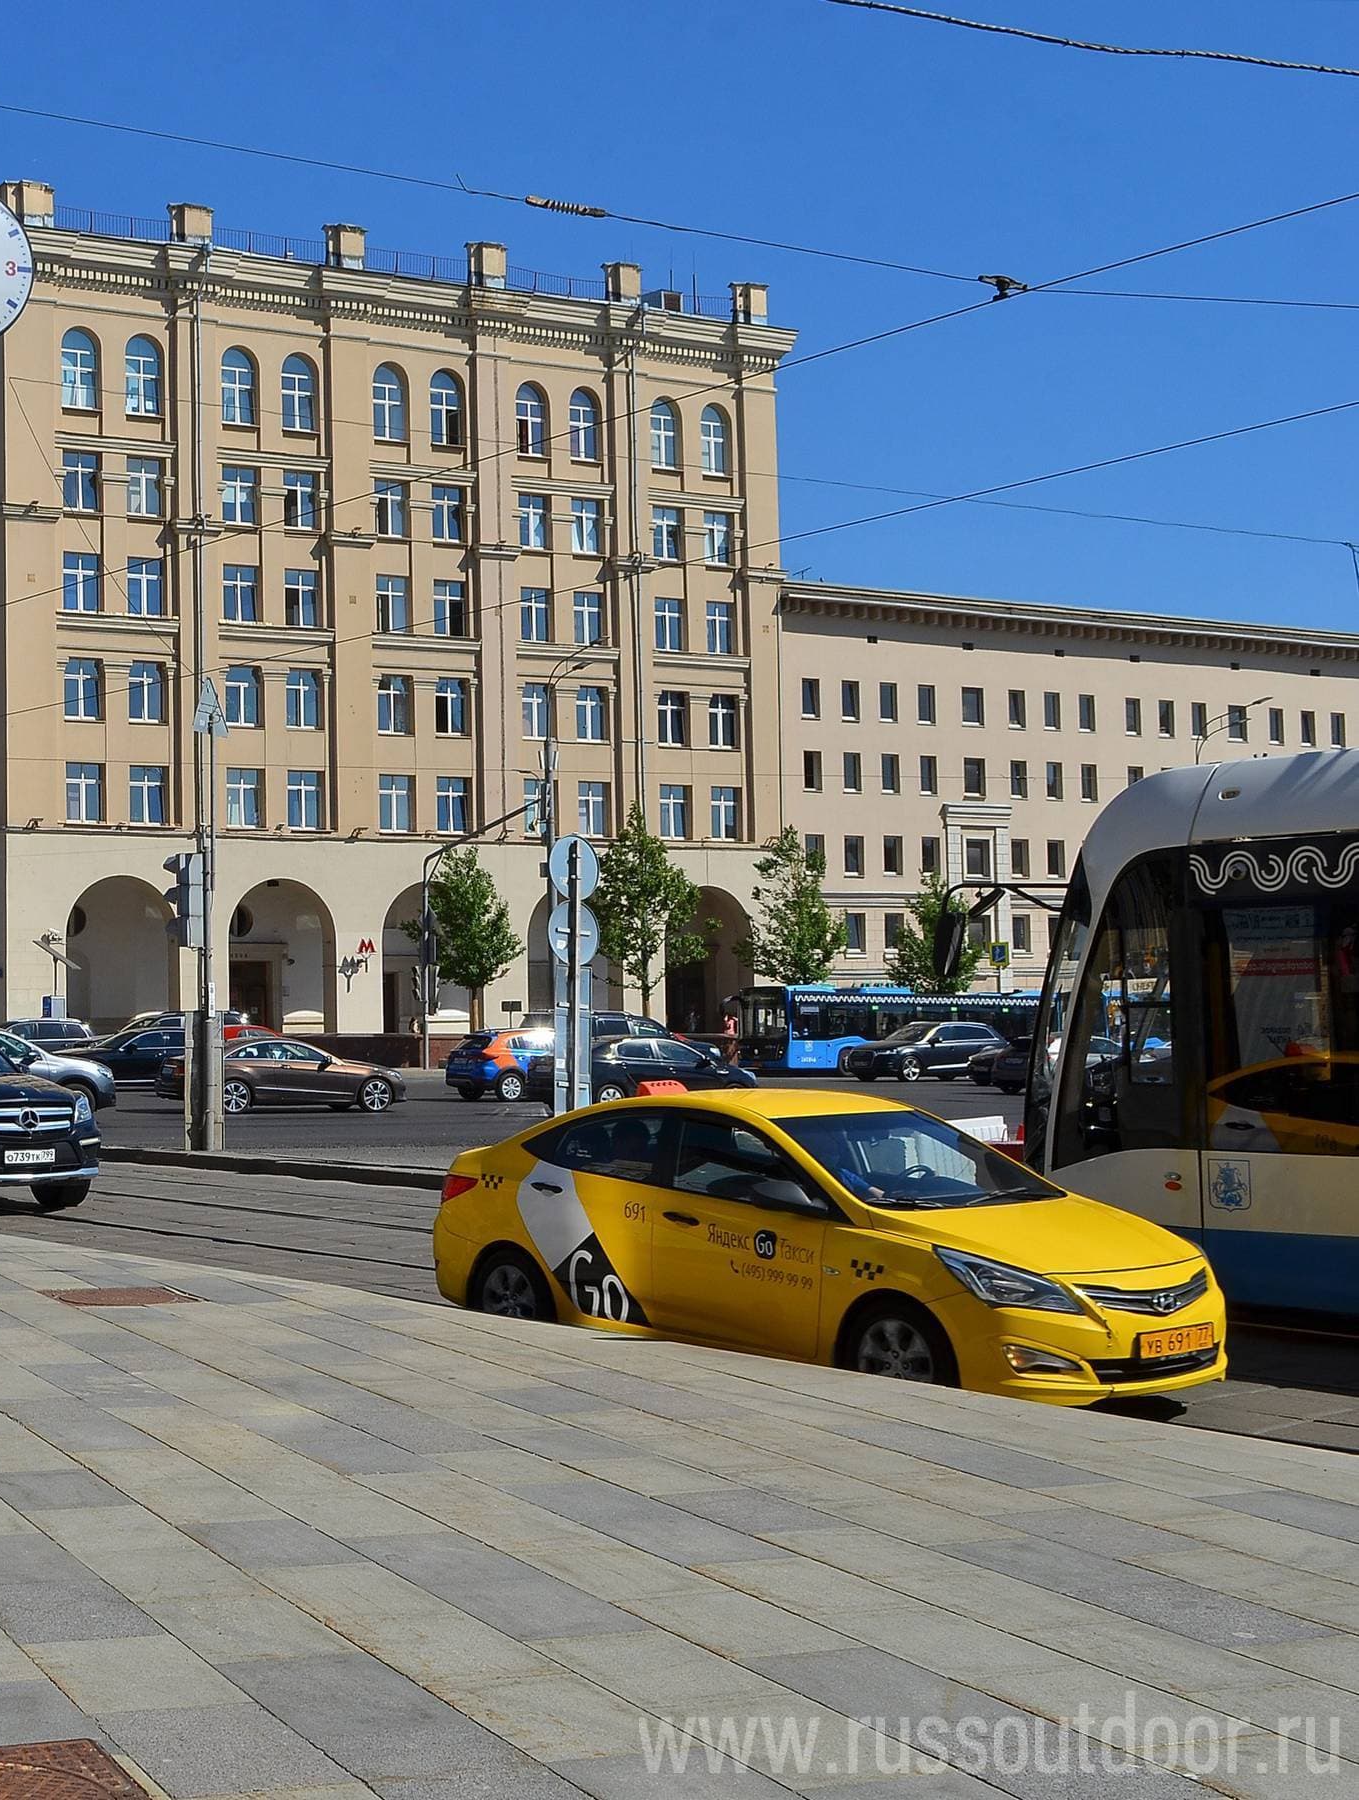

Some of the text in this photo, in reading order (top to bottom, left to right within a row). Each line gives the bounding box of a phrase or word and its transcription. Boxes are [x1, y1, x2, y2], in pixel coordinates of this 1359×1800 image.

[5, 261, 17, 277] 3
[624, 1200, 645, 1224] 691
[707, 1223, 814, 1265] Яндекс Go Такси
[569, 1250, 629, 1323] Go
[741, 1262, 814, 1290] (495) 999 99 99
[1168, 1331, 1191, 1351] 691
[1197, 1326, 1209, 1341] 77
